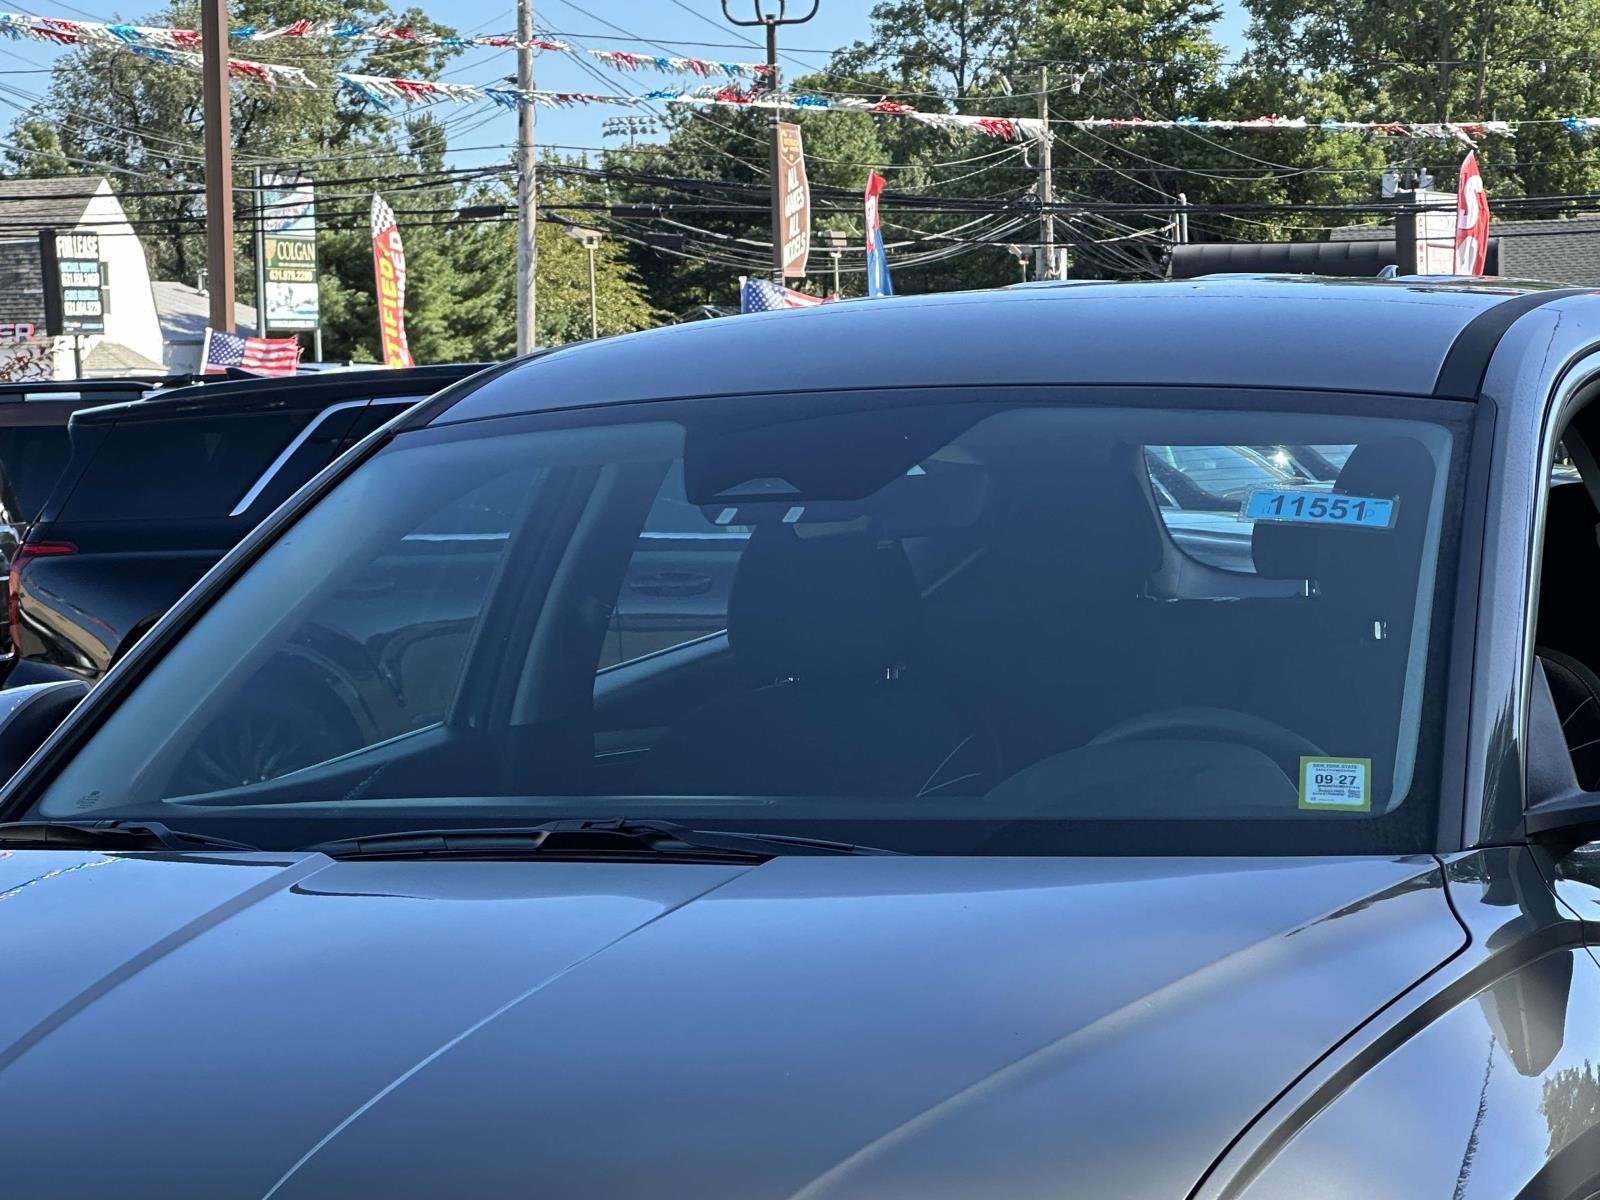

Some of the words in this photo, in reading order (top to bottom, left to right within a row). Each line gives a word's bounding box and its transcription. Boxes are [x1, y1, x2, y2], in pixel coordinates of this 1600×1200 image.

[277, 241, 316, 261] COLGAN
[1270, 494, 1366, 522] 11551
[1315, 774, 1334, 784] 09
[1338, 774, 1357, 786] 27
